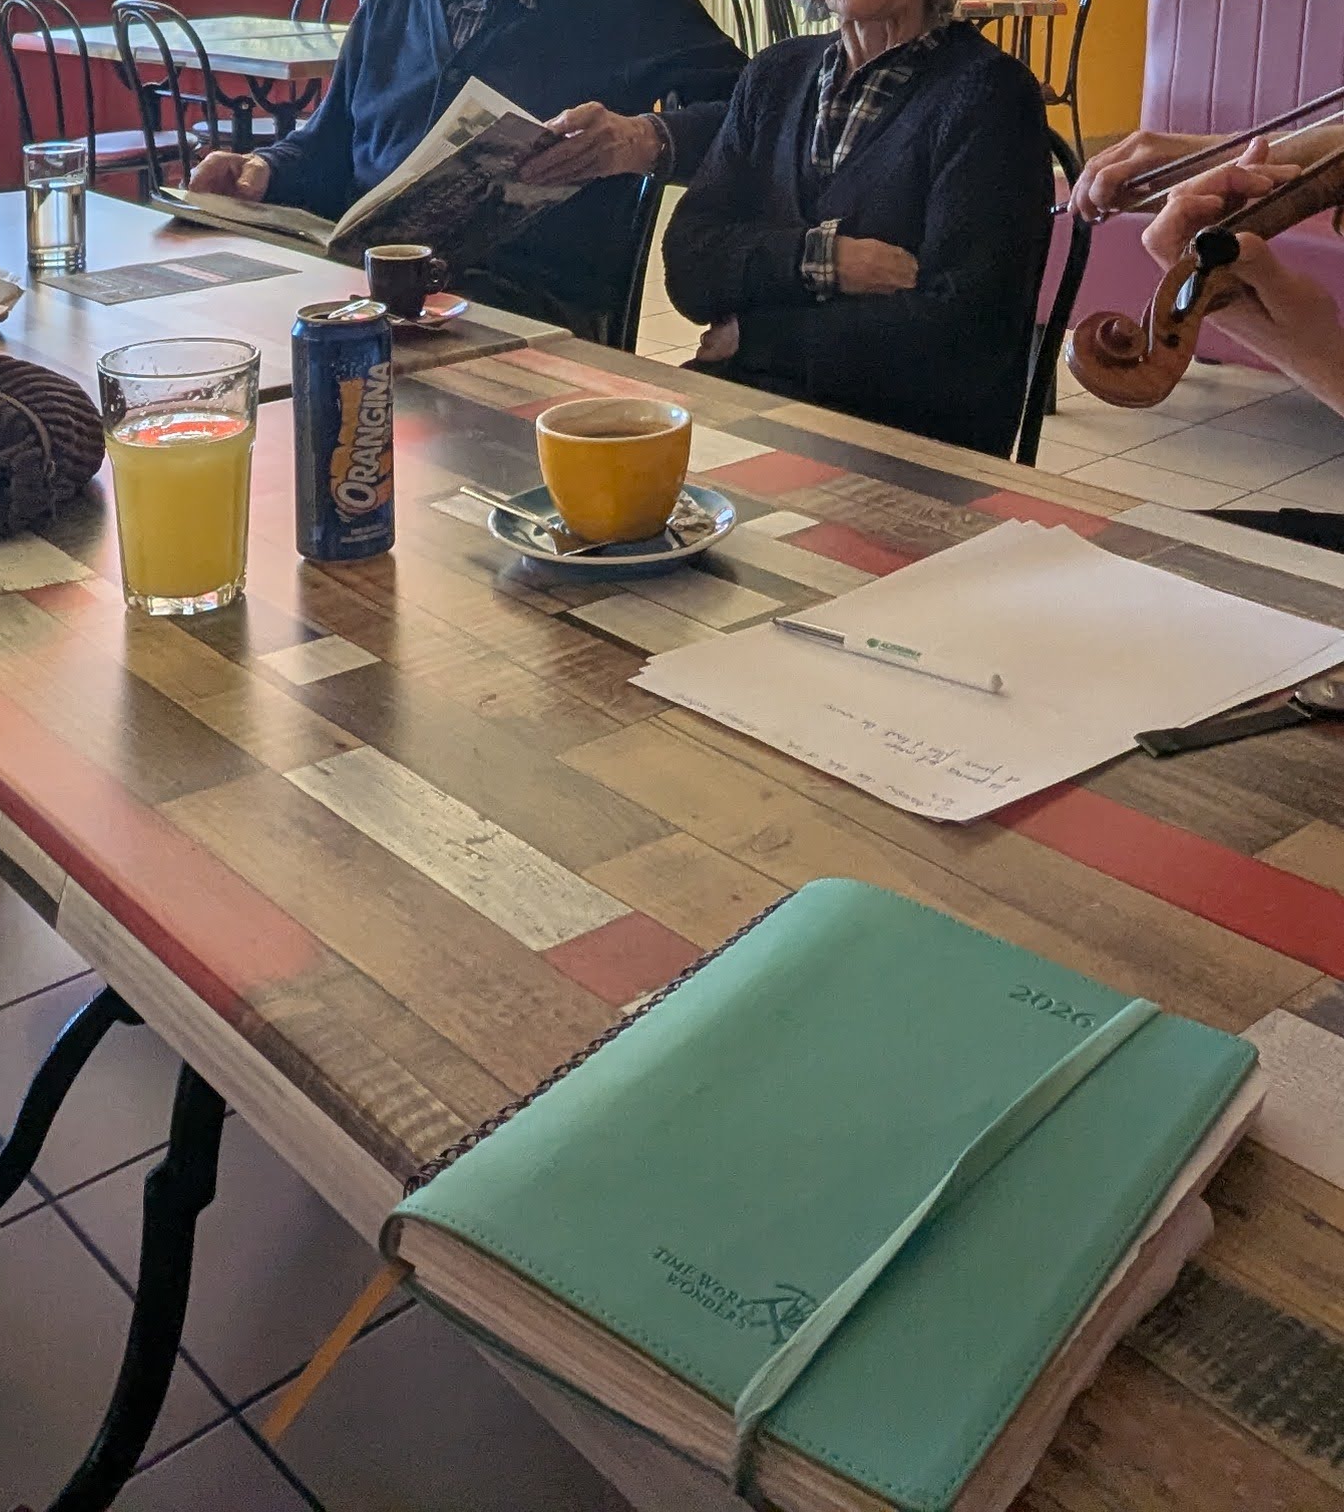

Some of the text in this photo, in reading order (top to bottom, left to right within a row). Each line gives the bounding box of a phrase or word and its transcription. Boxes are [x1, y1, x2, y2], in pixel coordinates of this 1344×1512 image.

[335, 360, 392, 512] ORANGINA
[1008, 984, 1097, 1029] 2026
[649, 1245, 698, 1279] TIME
[666, 1271, 749, 1330] WONDERS
